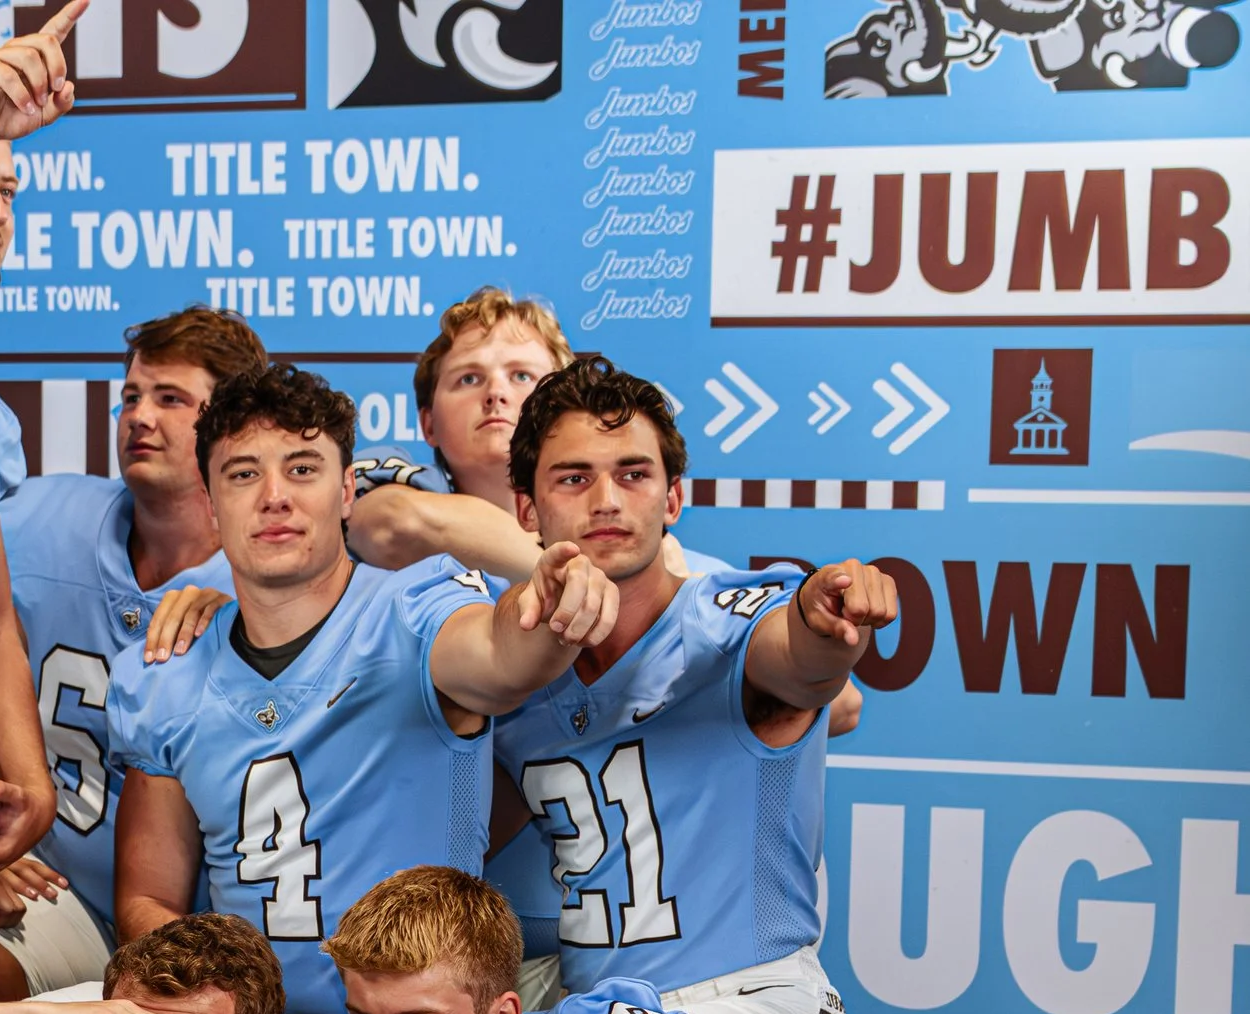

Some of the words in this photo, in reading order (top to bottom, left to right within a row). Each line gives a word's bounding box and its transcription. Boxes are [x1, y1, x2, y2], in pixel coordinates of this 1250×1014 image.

[589, 35, 702, 81] Jumbos
[584, 85, 697, 130] Jumbos
[166, 142, 287, 196] TITLE
[305, 137, 479, 195] TOWN.
[584, 124, 696, 169] Jumbos
[583, 164, 695, 208] Jumbos
[71, 209, 254, 270] TOWN.
[284, 218, 376, 260] TITLE
[387, 215, 518, 259] TOWN.
[582, 204, 694, 248] Jumbos
[770, 167, 1231, 295] #JUMB
[581, 249, 693, 292] Jumbos
[45, 285, 120, 311] TOWN.
[206, 276, 295, 318] TITLE
[307, 275, 435, 318] TOWN.
[580, 289, 692, 331] Jumbos
[749, 555, 1191, 700] OWN
[236, 751, 324, 943] 4
[520, 738, 682, 950] 21
